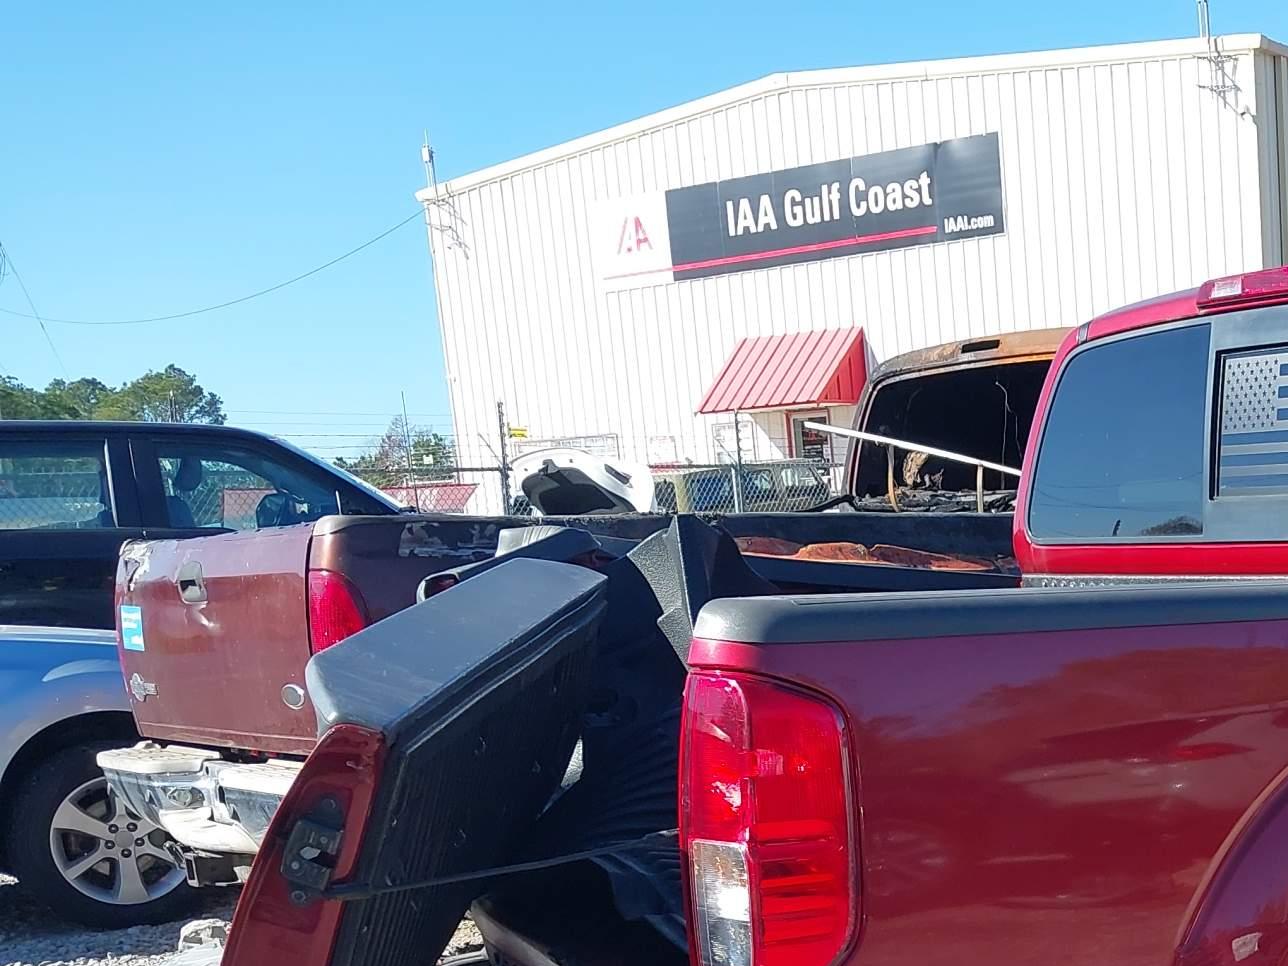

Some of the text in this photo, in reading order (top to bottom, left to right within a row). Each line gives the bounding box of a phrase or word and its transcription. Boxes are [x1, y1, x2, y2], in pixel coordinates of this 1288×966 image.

[725, 170, 933, 237] IAA Gulf Coast
